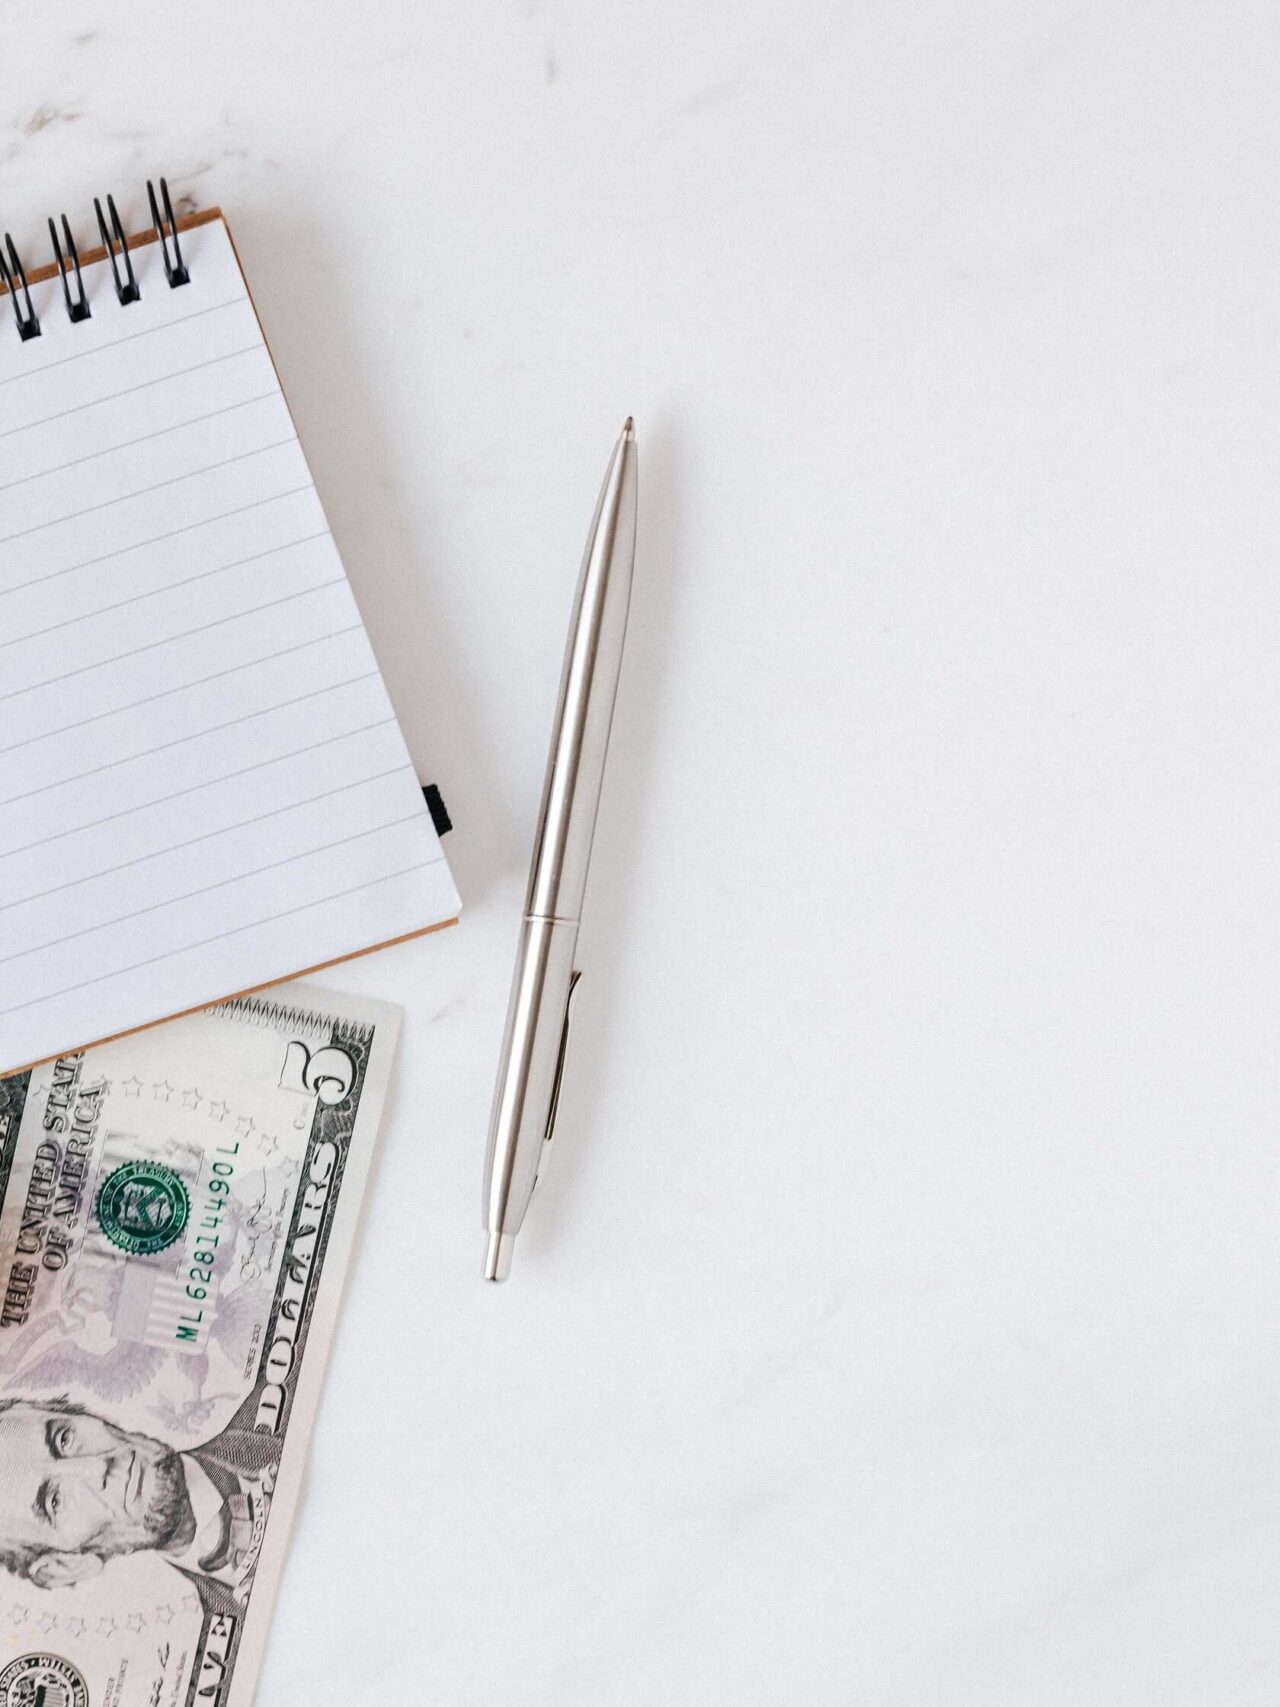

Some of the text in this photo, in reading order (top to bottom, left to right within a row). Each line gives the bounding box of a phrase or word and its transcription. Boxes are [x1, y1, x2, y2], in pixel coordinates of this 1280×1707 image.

[278, 1040, 359, 1106] 5
[14, 1139, 61, 1257] UNITED
[42, 1082, 108, 1272] OF AMERICA
[0, 1261, 39, 1329] THE
[253, 1140, 340, 1435] DOLLARS
[243, 1497, 265, 1571] LINCOLN
